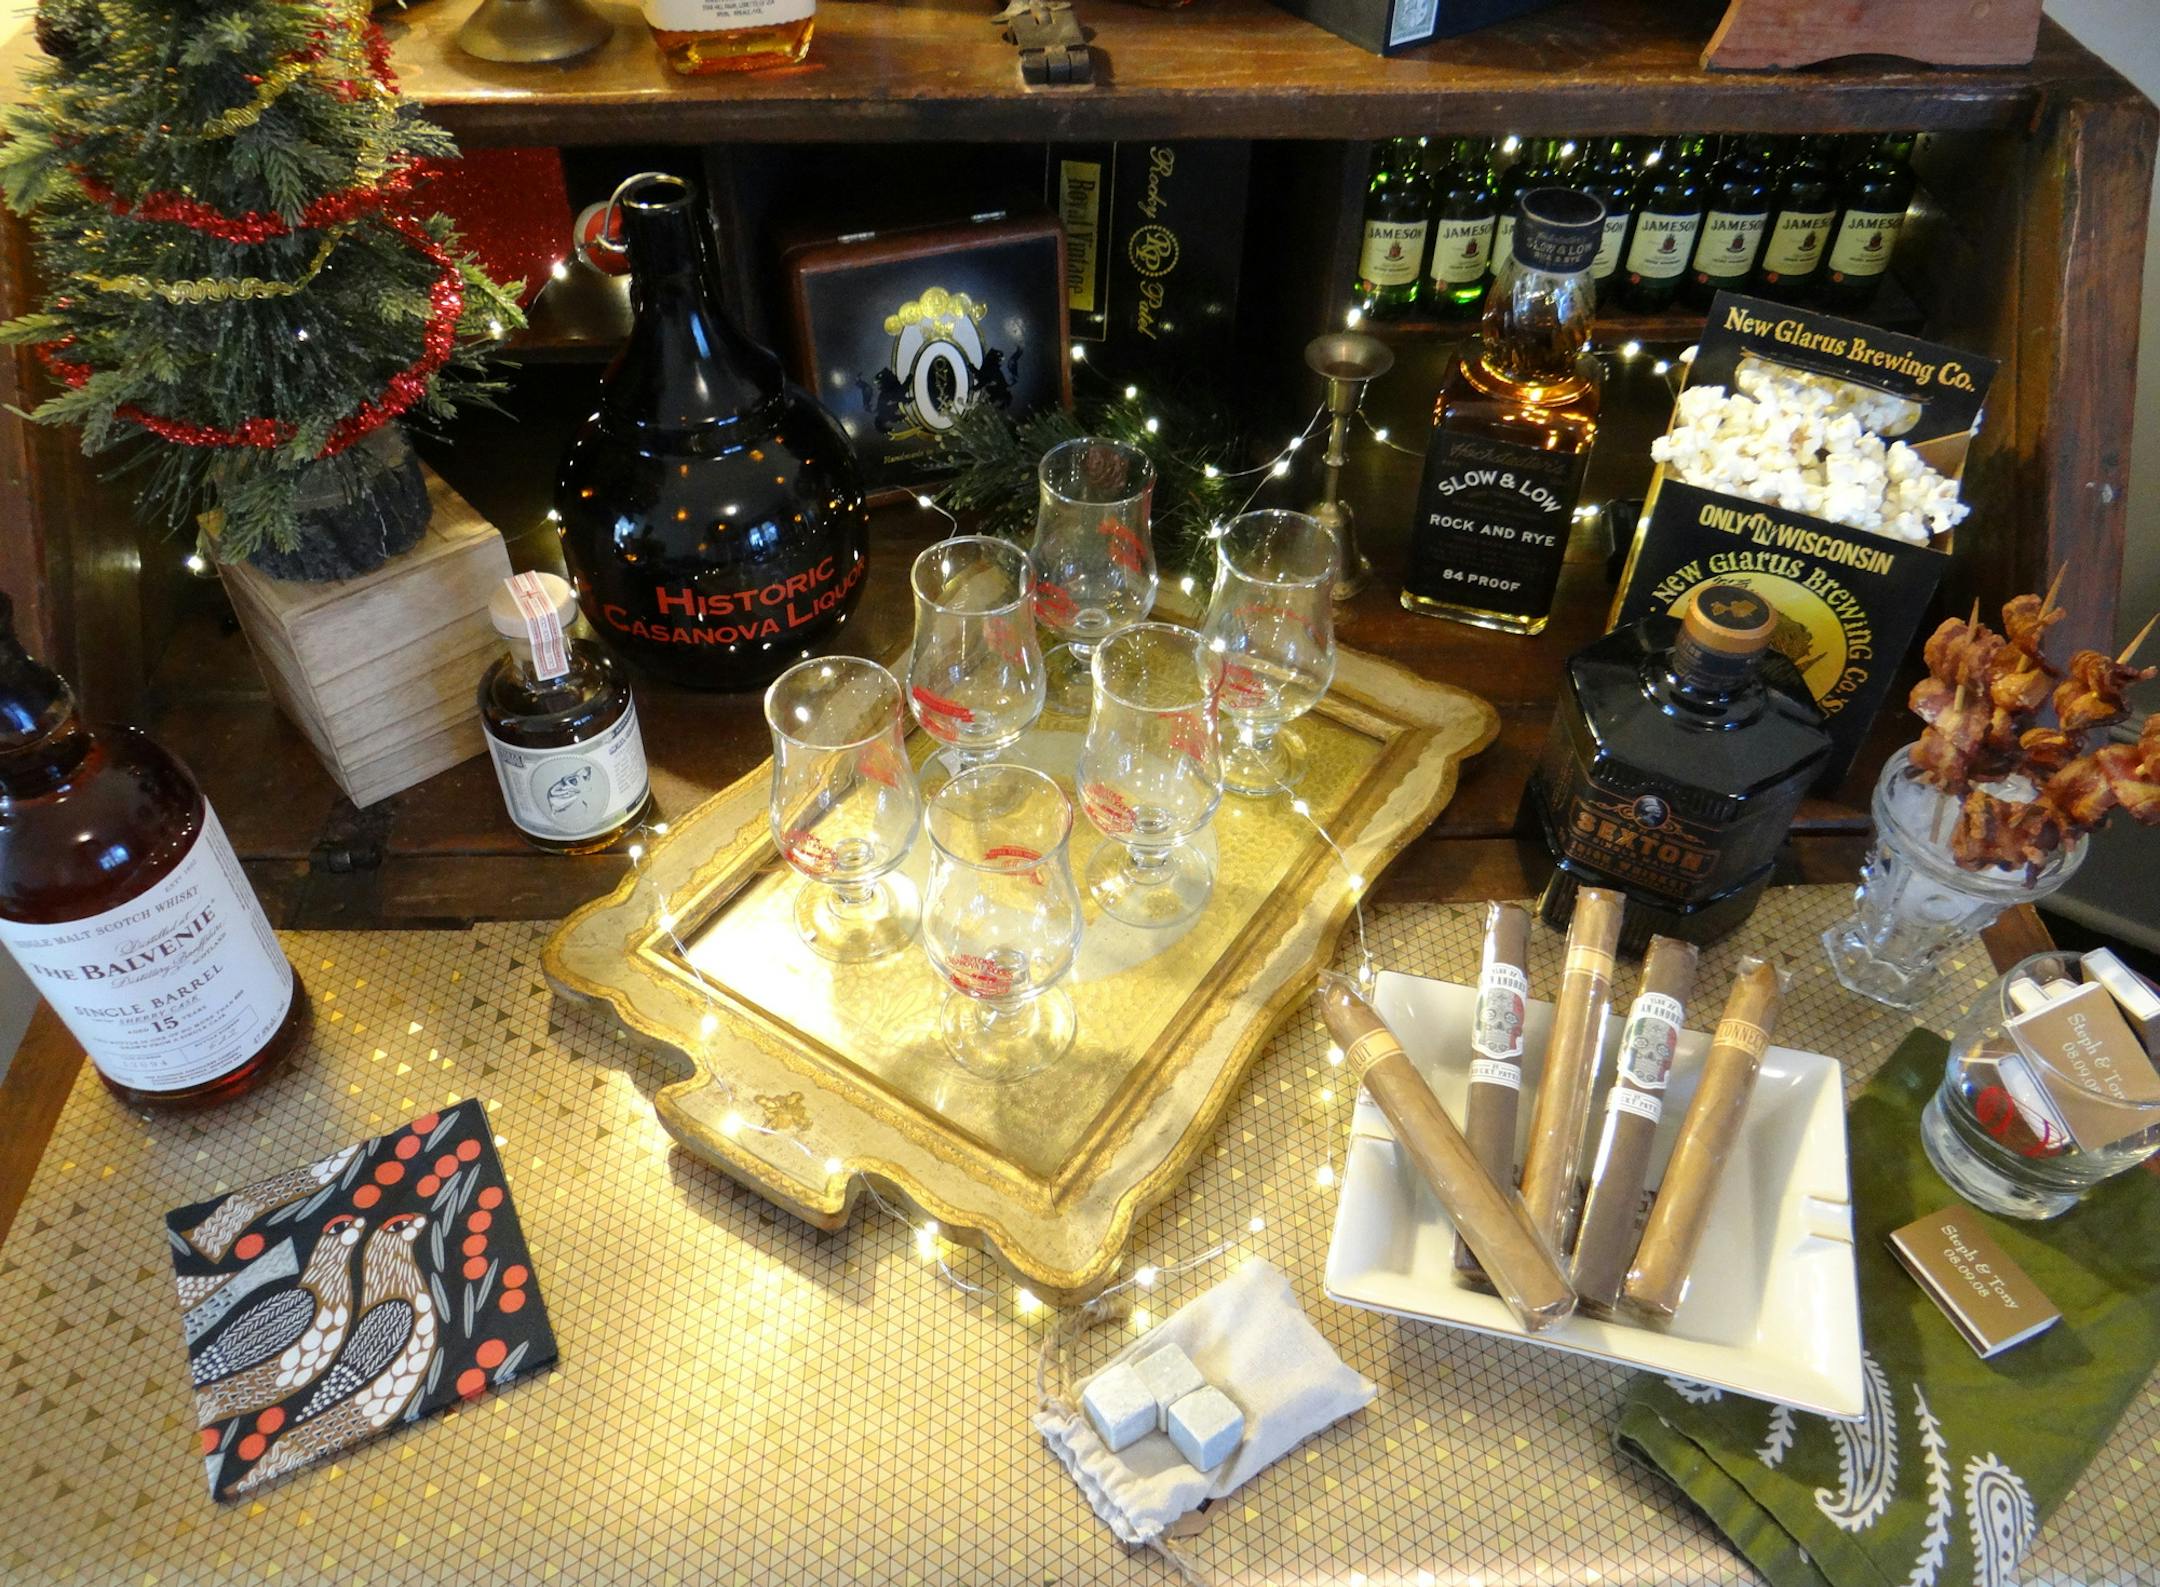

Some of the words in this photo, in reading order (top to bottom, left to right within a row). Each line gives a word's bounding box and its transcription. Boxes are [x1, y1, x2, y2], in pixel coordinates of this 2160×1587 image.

[1723, 307, 1774, 338] New
[1774, 319, 1848, 357] Glarus
[1847, 337, 1936, 385] Brewing
[1438, 470, 1498, 496] SLOW
[1500, 472, 1517, 489] &
[1519, 480, 1562, 514] LOW
[1429, 514, 1475, 532] ROCK
[1480, 524, 1516, 540] AND
[1521, 531, 1556, 547] RYE
[1699, 503, 1751, 535] ONLY
[1776, 523, 1895, 576] WISCONSIN
[656, 556, 836, 617] HISTORIC
[1443, 568, 1464, 582] 84
[1467, 574, 1521, 592] PROOF
[1651, 560, 1704, 605] New
[1708, 550, 1806, 579] Glarus
[603, 603, 780, 645] CASANOVA
[30, 962, 79, 981] THE
[79, 904, 216, 981] BALVENIE
[95, 908, 152, 936] SCOTCH
[74, 1004, 145, 1019] SINGLE
[151, 964, 224, 1009] BARREL
[152, 1016, 179, 1033] 15
[2066, 1013, 2103, 1055] Steph
[2094, 1056, 2112, 1069] &
[1940, 1224, 1979, 1262] Steph
[1974, 1263, 1991, 1274] &
[1988, 1274, 2019, 1309] Tony
